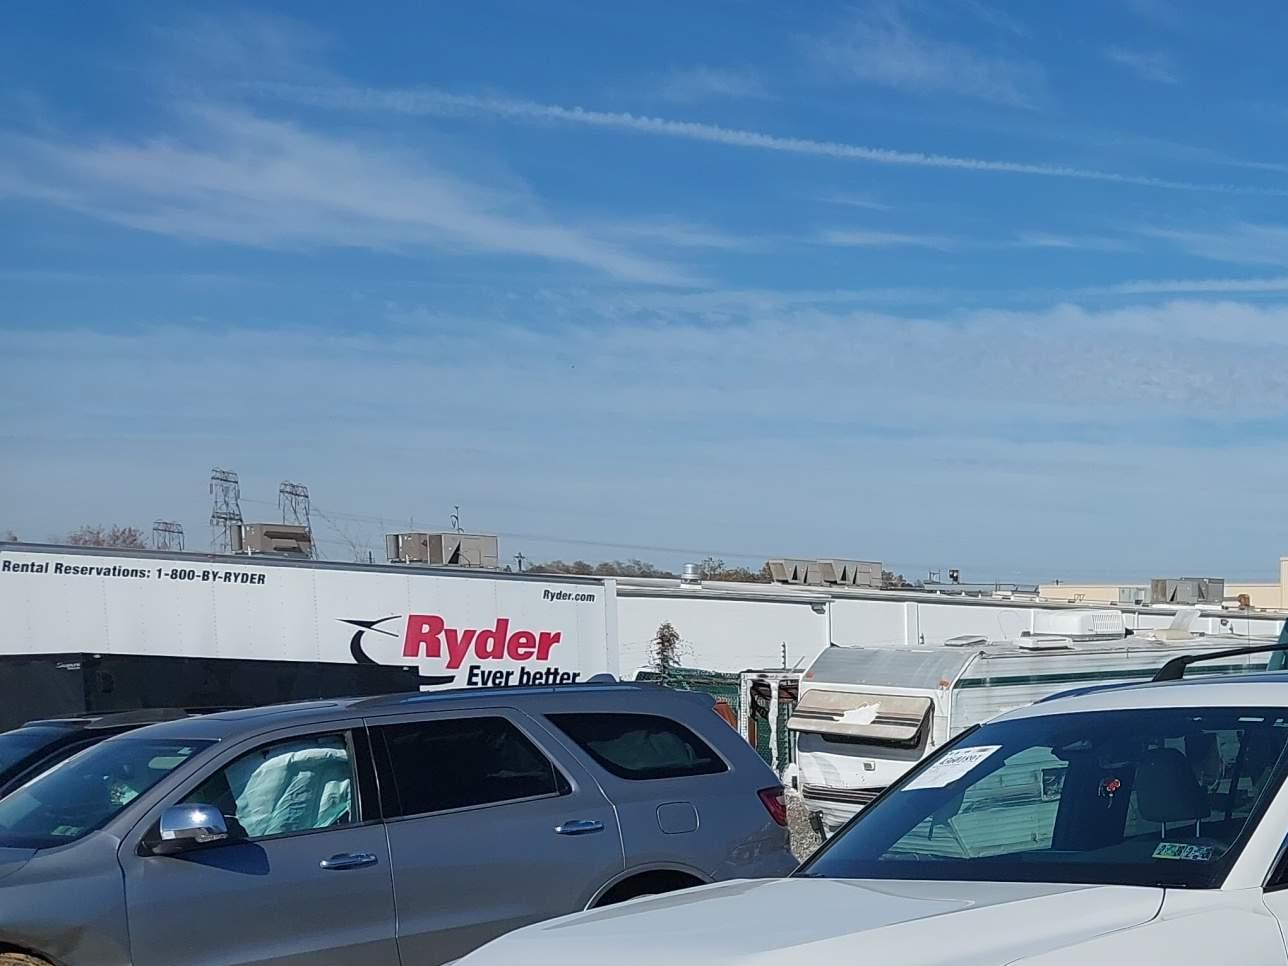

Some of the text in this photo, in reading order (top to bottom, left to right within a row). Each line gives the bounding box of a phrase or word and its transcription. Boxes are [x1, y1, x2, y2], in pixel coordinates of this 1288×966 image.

[2, 560, 266, 585] Rental Reservations: 1-800-BY-RYDER
[543, 589, 595, 602] Ryder.com
[403, 614, 561, 669] Ryder
[466, 665, 580, 687] Ever better
